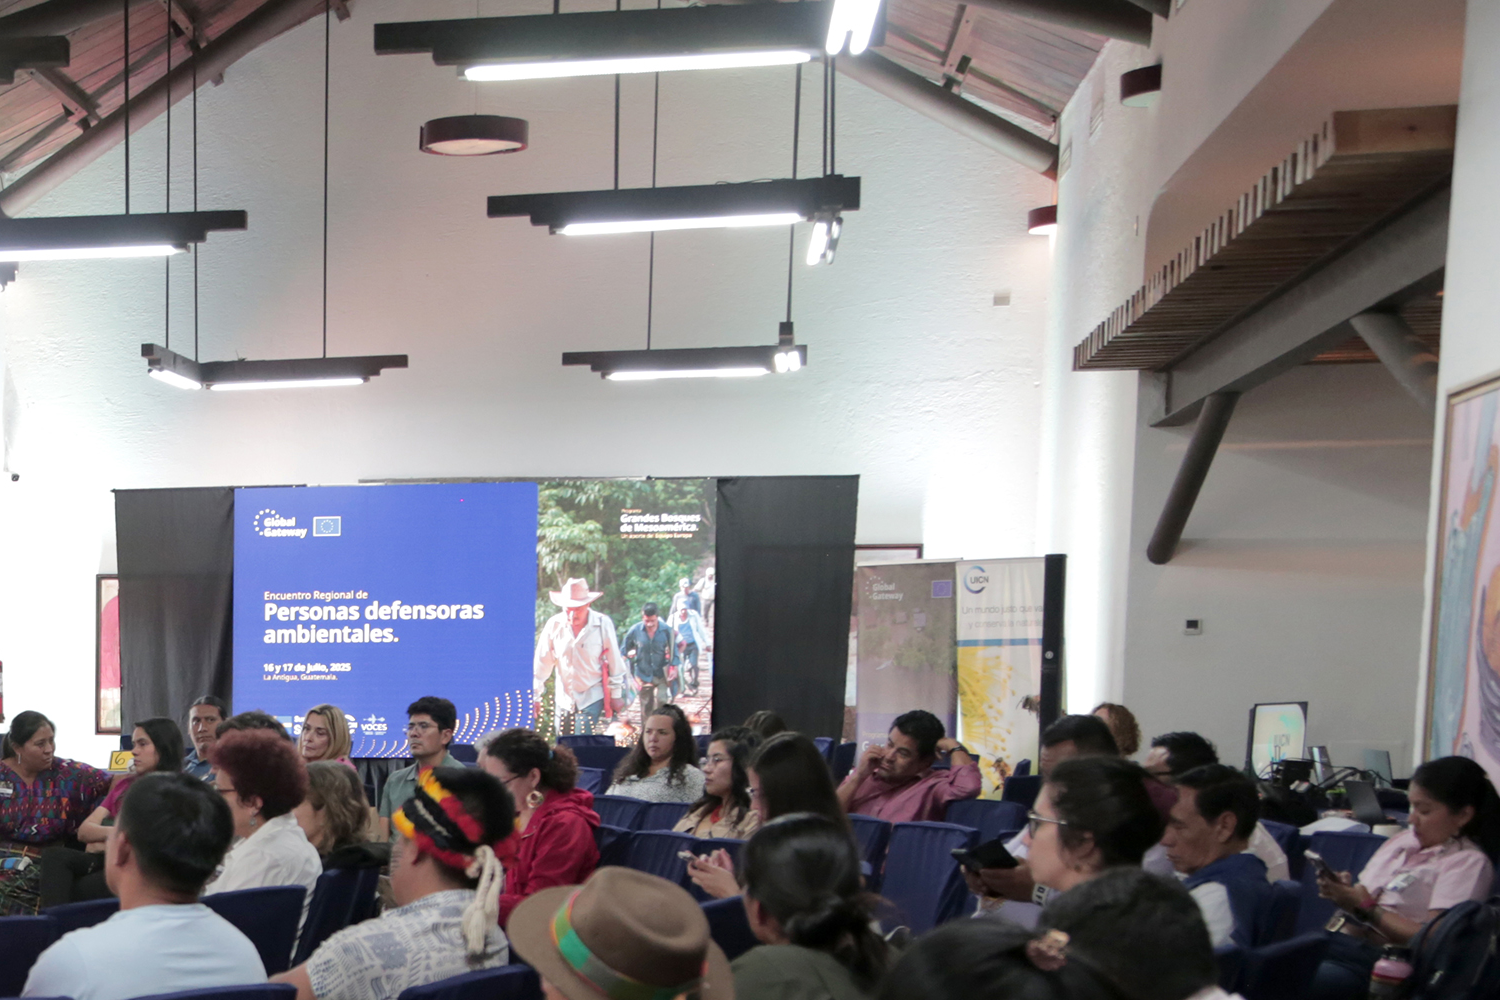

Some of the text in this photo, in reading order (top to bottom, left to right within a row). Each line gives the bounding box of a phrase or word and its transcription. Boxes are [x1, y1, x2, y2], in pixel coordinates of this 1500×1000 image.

[263, 516, 296, 527] Global
[620, 514, 701, 524] Grandes Bosques
[620, 522, 699, 532] de Mesoamérica.
[263, 528, 308, 539] Gateway
[970, 576, 990, 584] UICN
[872, 583, 895, 592] Global
[264, 590, 368, 602] Encuentro Regional de
[872, 592, 904, 602] Gateway
[264, 600, 484, 621] Personas defensoras
[962, 606, 974, 615] Un
[975, 606, 1000, 614] mundo
[1001, 606, 1018, 616] justo
[1020, 606, 1033, 616] que
[968, 621, 973, 630] y
[975, 620, 1006, 628] conserva
[1008, 619, 1014, 628] la
[263, 624, 400, 644] ambientales.
[263, 664, 274, 672] 16
[275, 664, 282, 674] y
[283, 663, 294, 672] 17
[294, 663, 306, 672] de
[330, 662, 352, 672] 2025
[115, 752, 126, 765] 6
